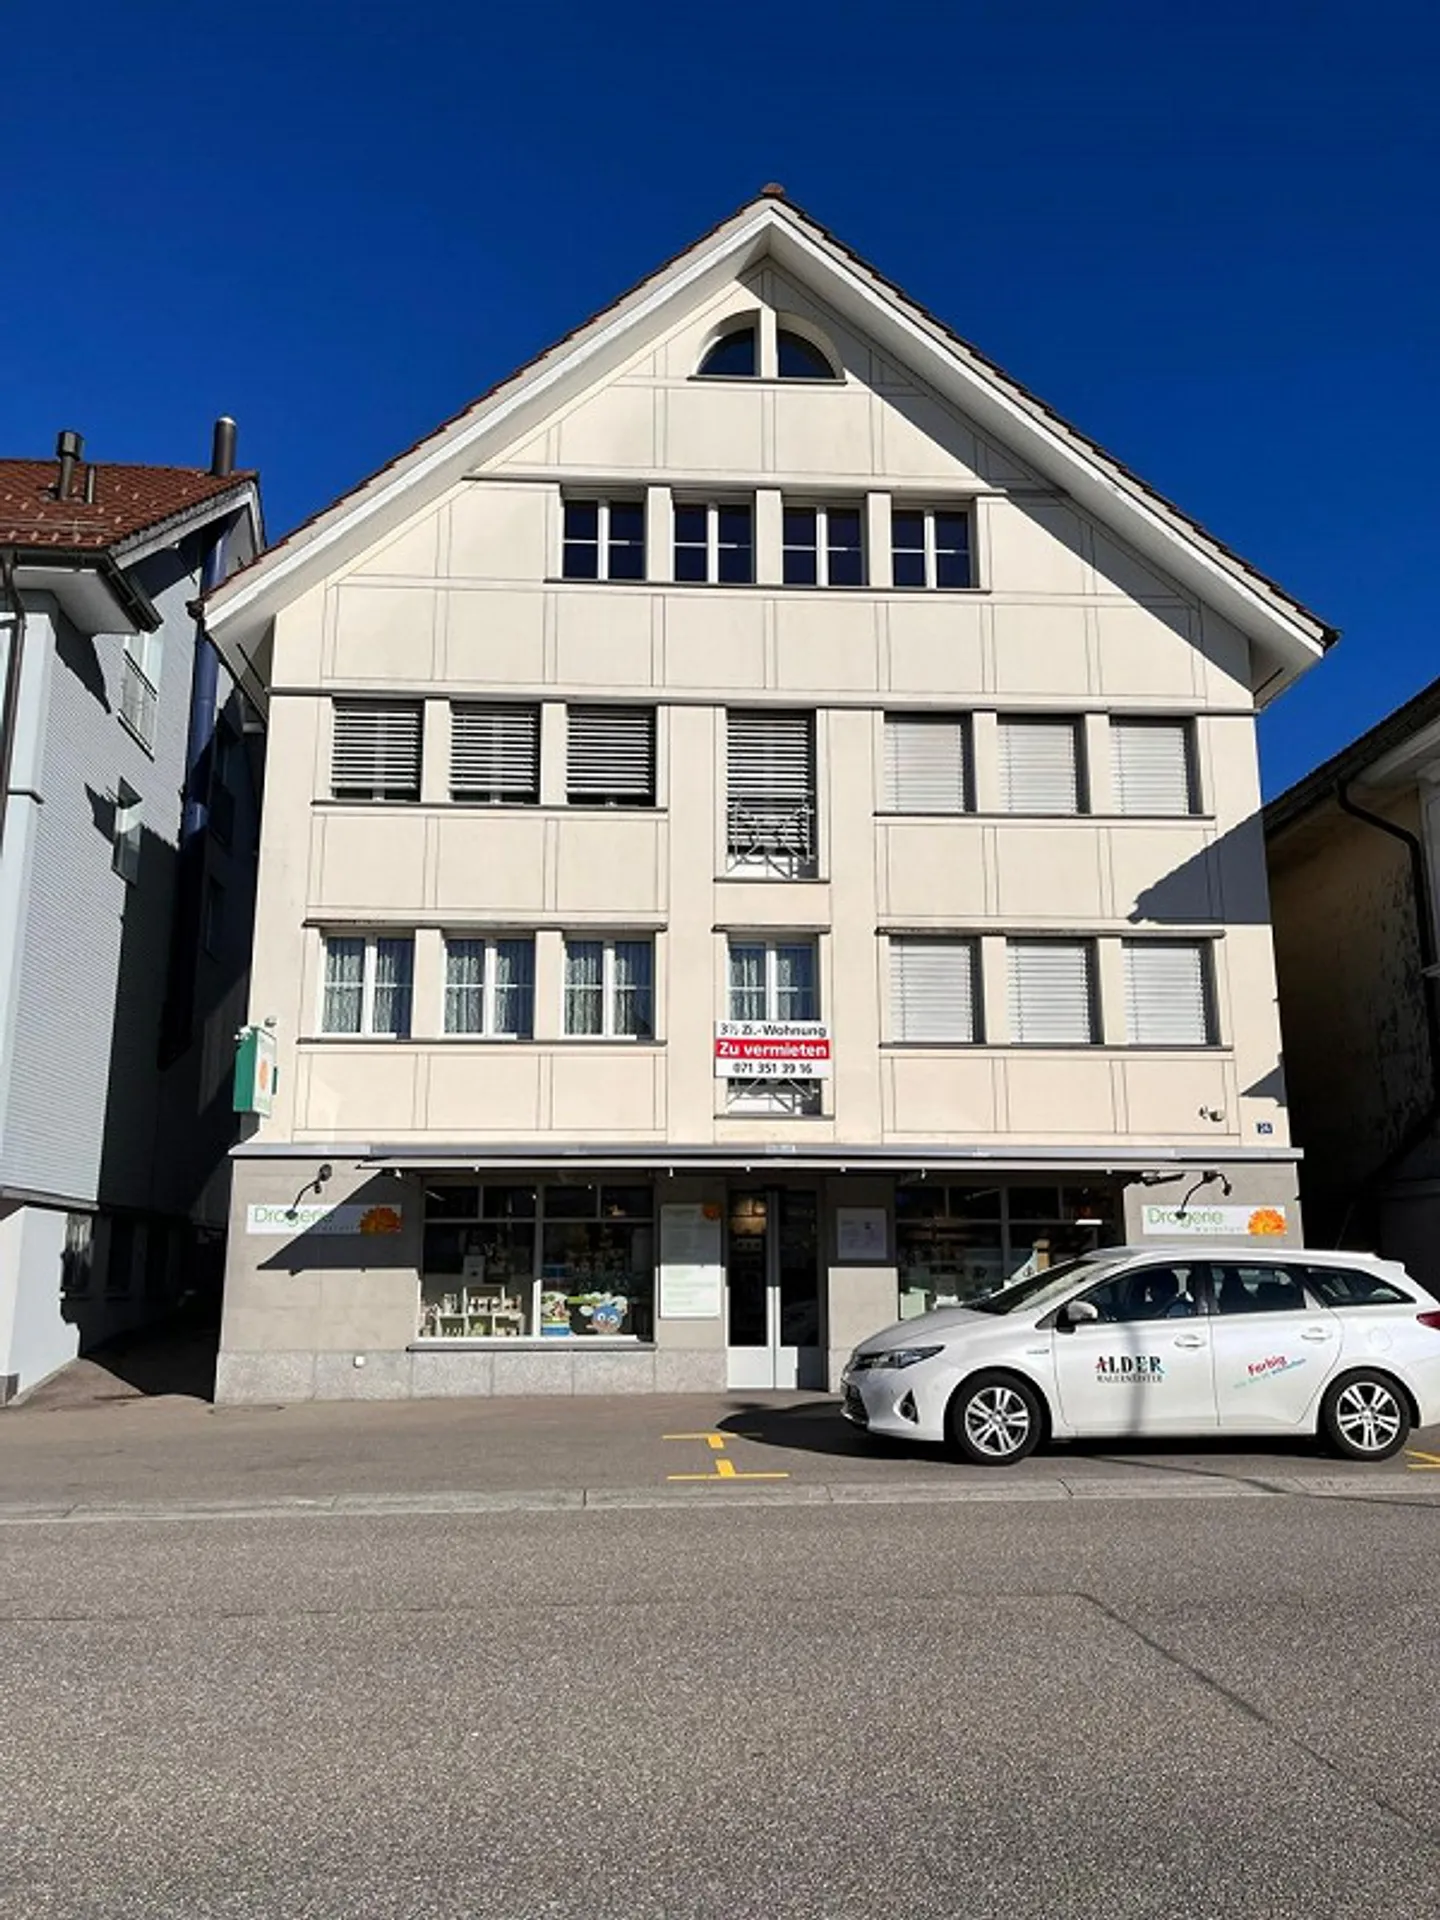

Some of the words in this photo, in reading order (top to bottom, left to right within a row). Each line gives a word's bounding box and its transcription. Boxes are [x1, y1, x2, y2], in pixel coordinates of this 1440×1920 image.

[742, 1025, 826, 1038] Zi.-Wohnung
[719, 1042, 740, 1055] Zu
[744, 1043, 827, 1057] vermieten
[732, 1062, 753, 1075] 071
[757, 1062, 778, 1075] 351
[781, 1062, 796, 1075] 39
[799, 1063, 813, 1075] 16
[1095, 1356, 1165, 1374] ALDER
